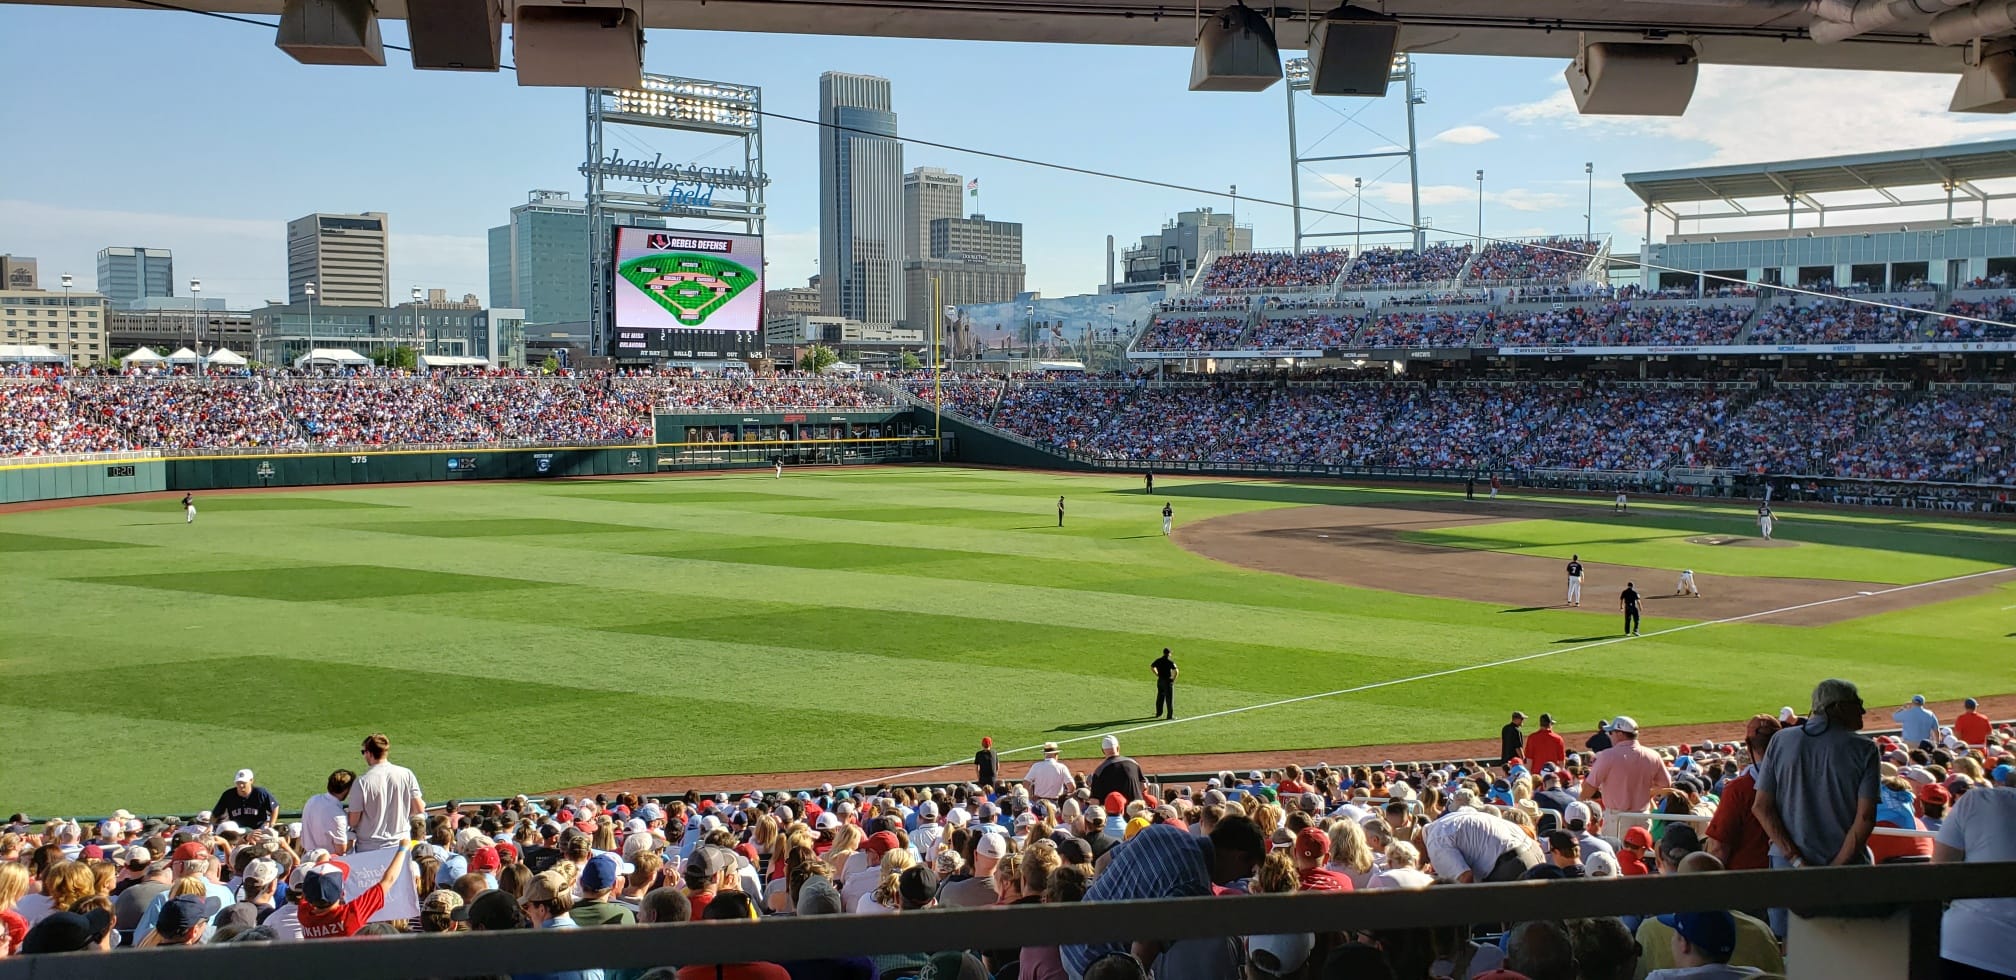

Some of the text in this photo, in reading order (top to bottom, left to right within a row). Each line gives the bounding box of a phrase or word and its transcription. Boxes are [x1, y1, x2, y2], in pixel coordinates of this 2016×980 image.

[925, 175, 958, 184] WoodmenLife
[662, 181, 715, 212] field
[671, 238, 728, 251] REBELS DEFENSE
[660, 333, 666, 341] 2
[784, 414, 807, 423] ESPN
[112, 466, 133, 476] 0:20
